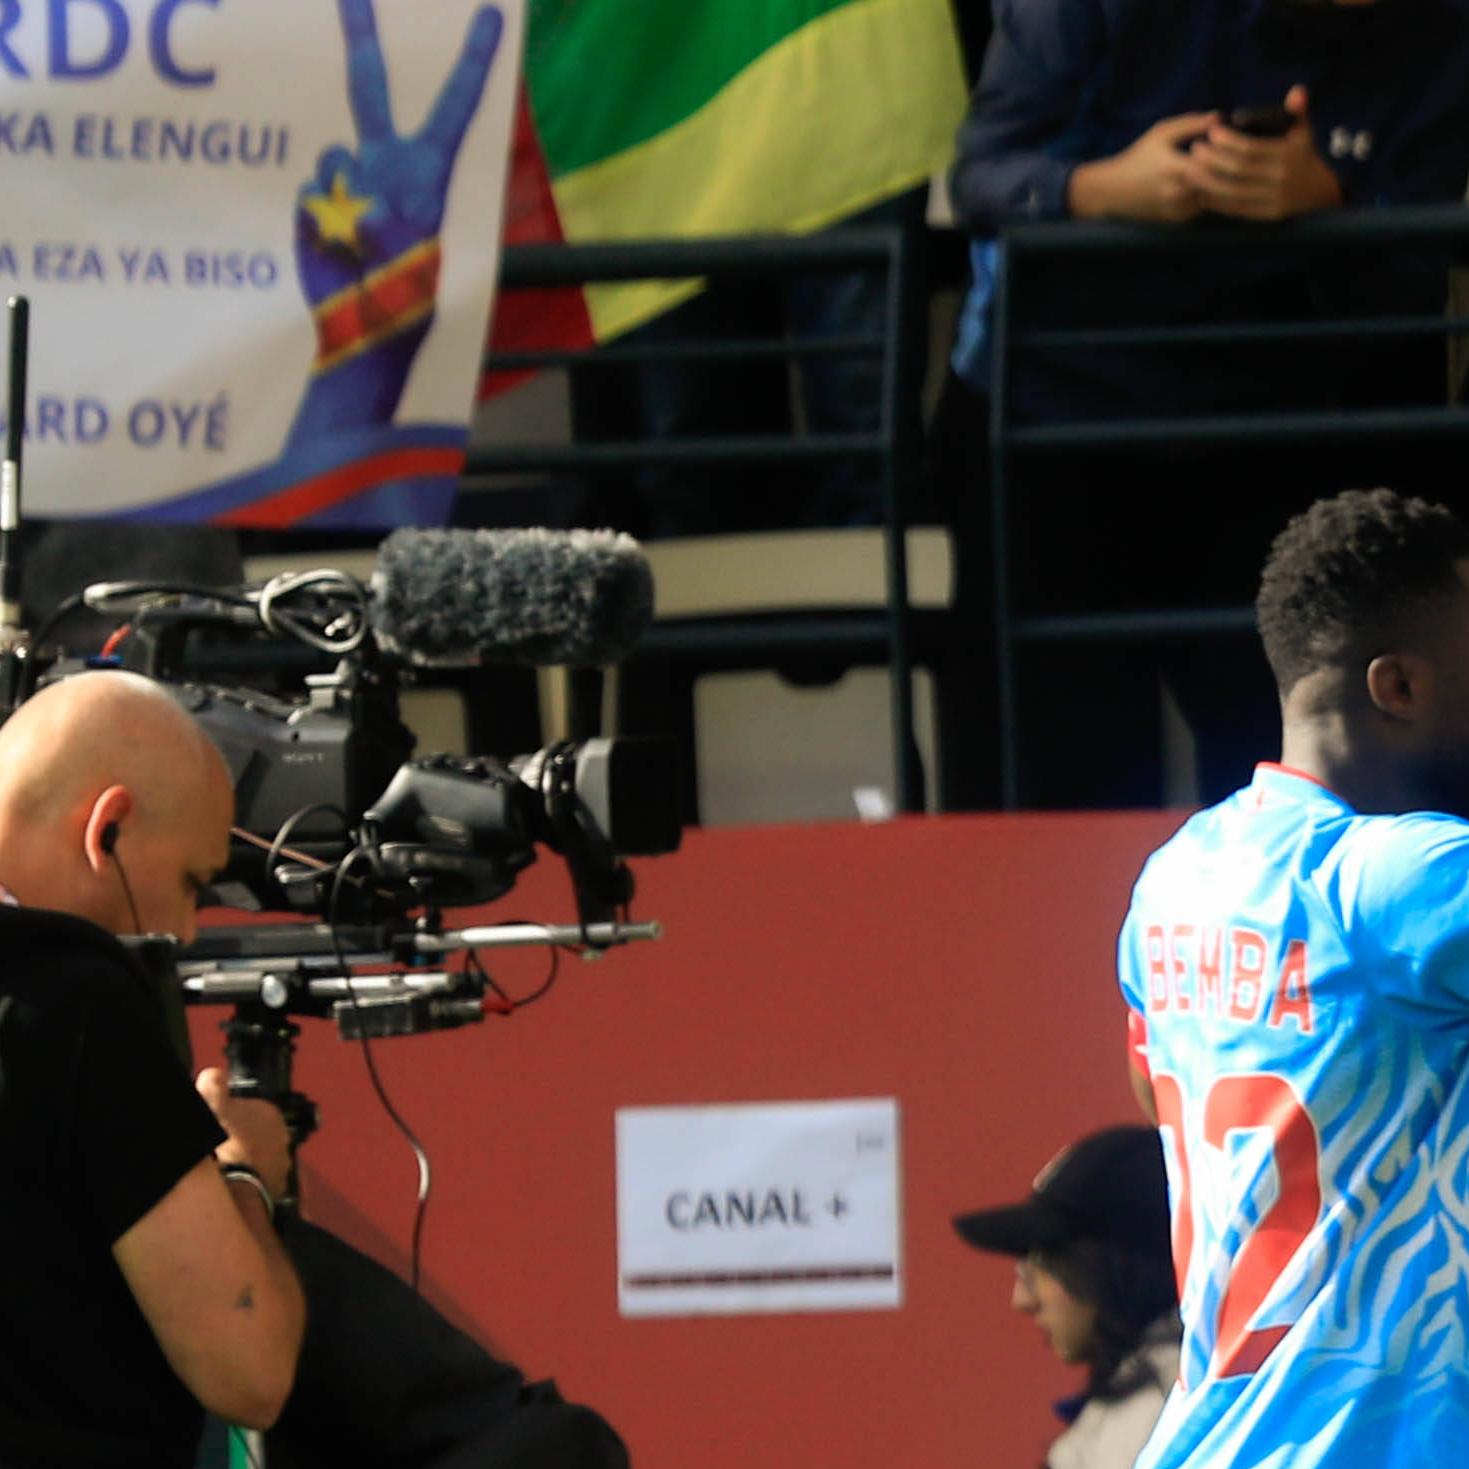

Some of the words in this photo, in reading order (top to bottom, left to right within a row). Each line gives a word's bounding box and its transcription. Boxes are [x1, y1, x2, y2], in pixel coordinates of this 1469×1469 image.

[74, 114, 290, 167] ELENGUI
[33, 245, 105, 284] EZA
[118, 248, 169, 285] YA
[184, 250, 279, 290] BISO
[128, 389, 229, 451] OYÉ
[1146, 923, 1315, 1035] BEMBA
[664, 1186, 815, 1231] CANAL
